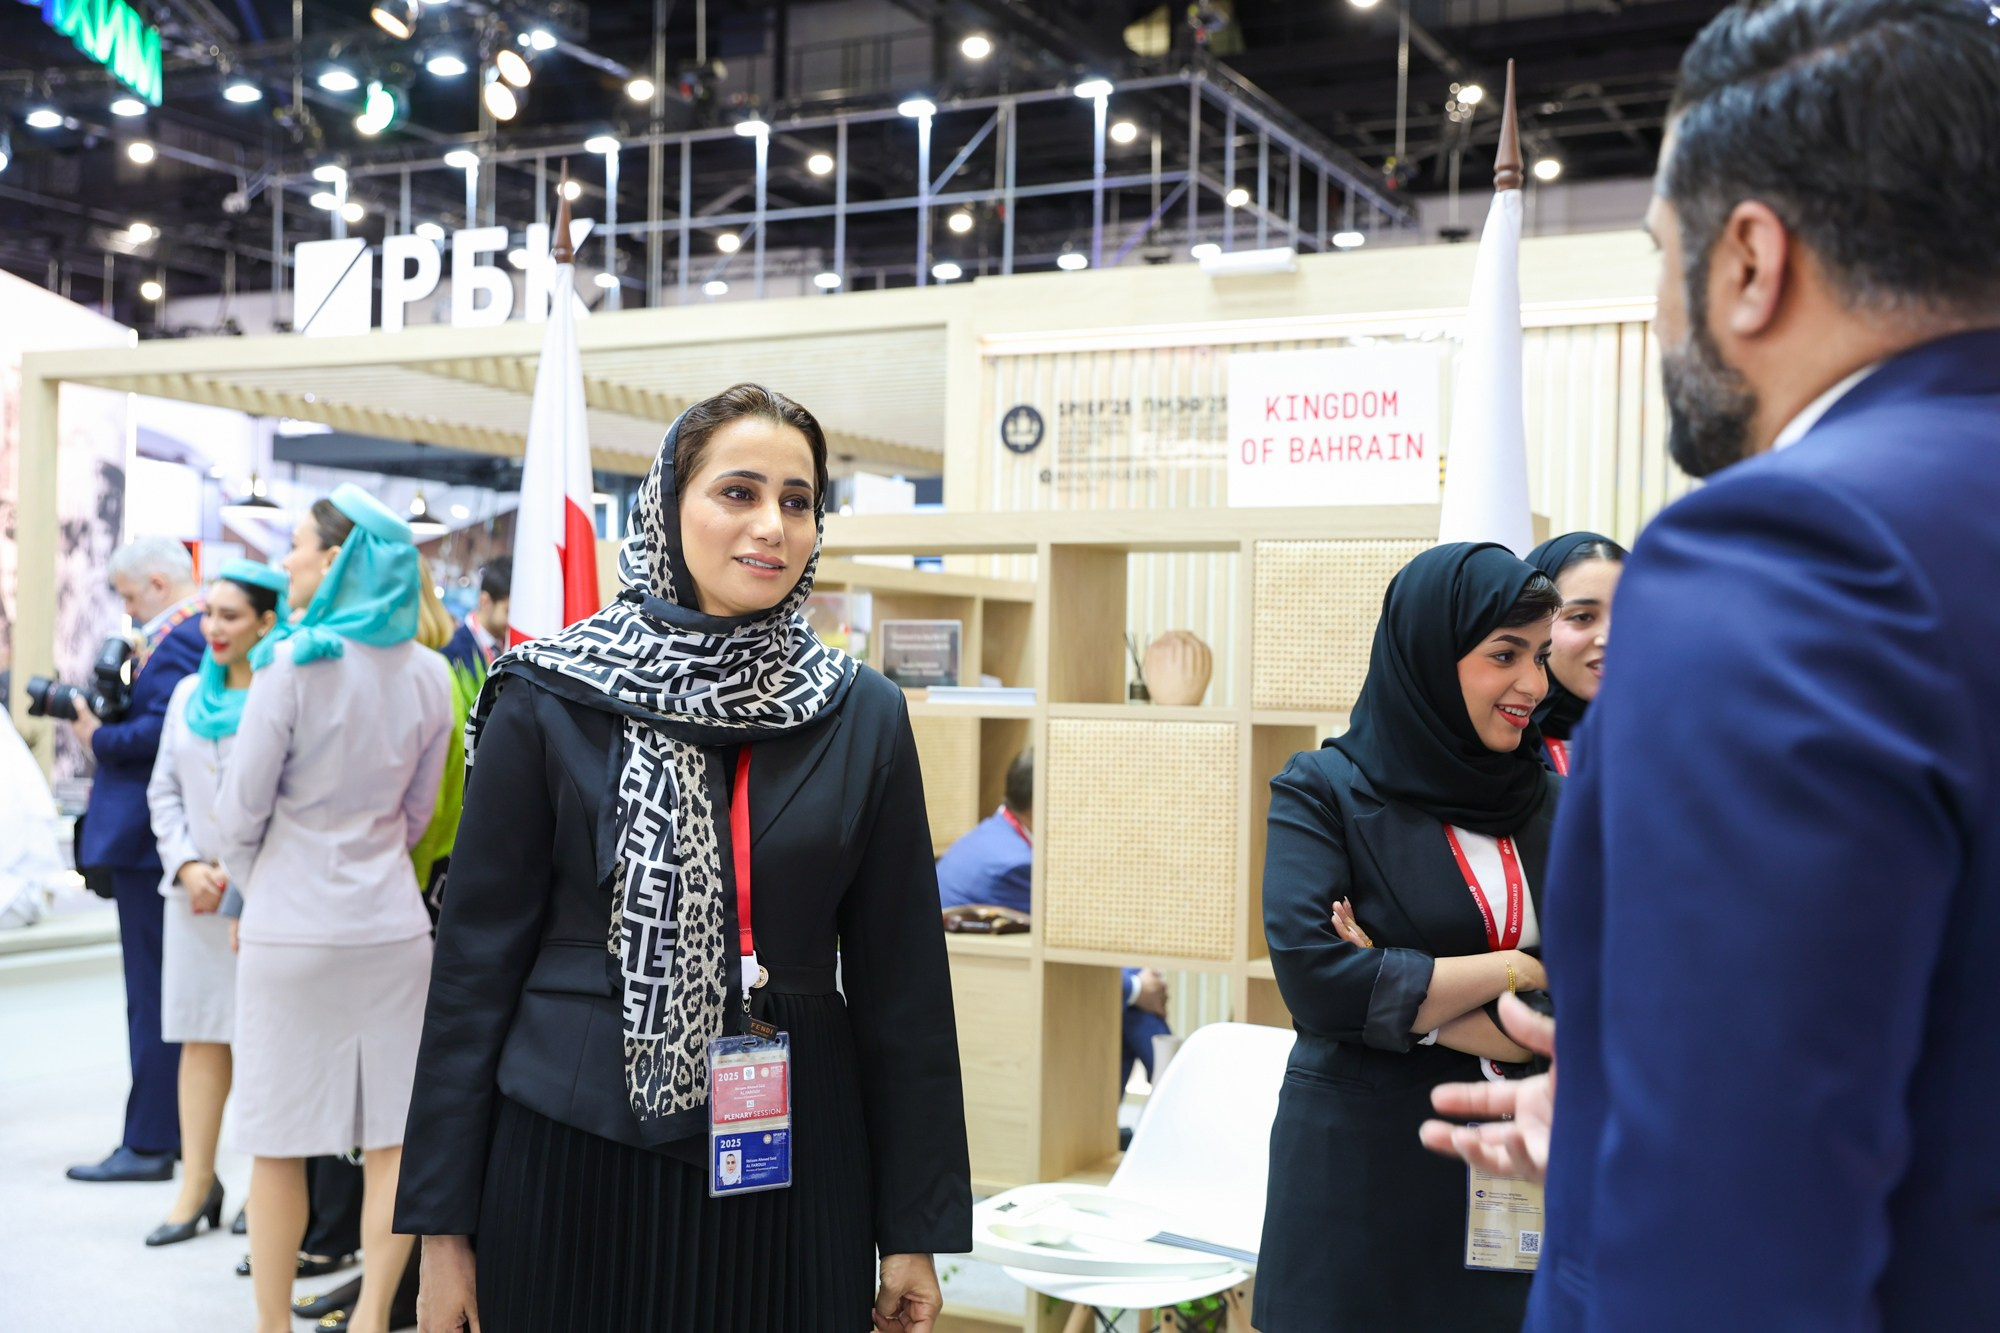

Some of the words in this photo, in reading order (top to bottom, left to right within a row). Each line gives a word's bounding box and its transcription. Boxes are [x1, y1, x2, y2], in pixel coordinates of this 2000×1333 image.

[381, 217, 595, 333] РБК
[1265, 390, 1399, 422] KINGDOM
[1241, 438, 1275, 466] OF
[1289, 433, 1424, 463] BAHRAIN
[751, 1022, 774, 1035] FENDI
[718, 1072, 739, 1082] 2025
[724, 1111, 753, 1121] PLENARY
[753, 1108, 781, 1117] SESSION
[720, 1138, 741, 1149] 2025
